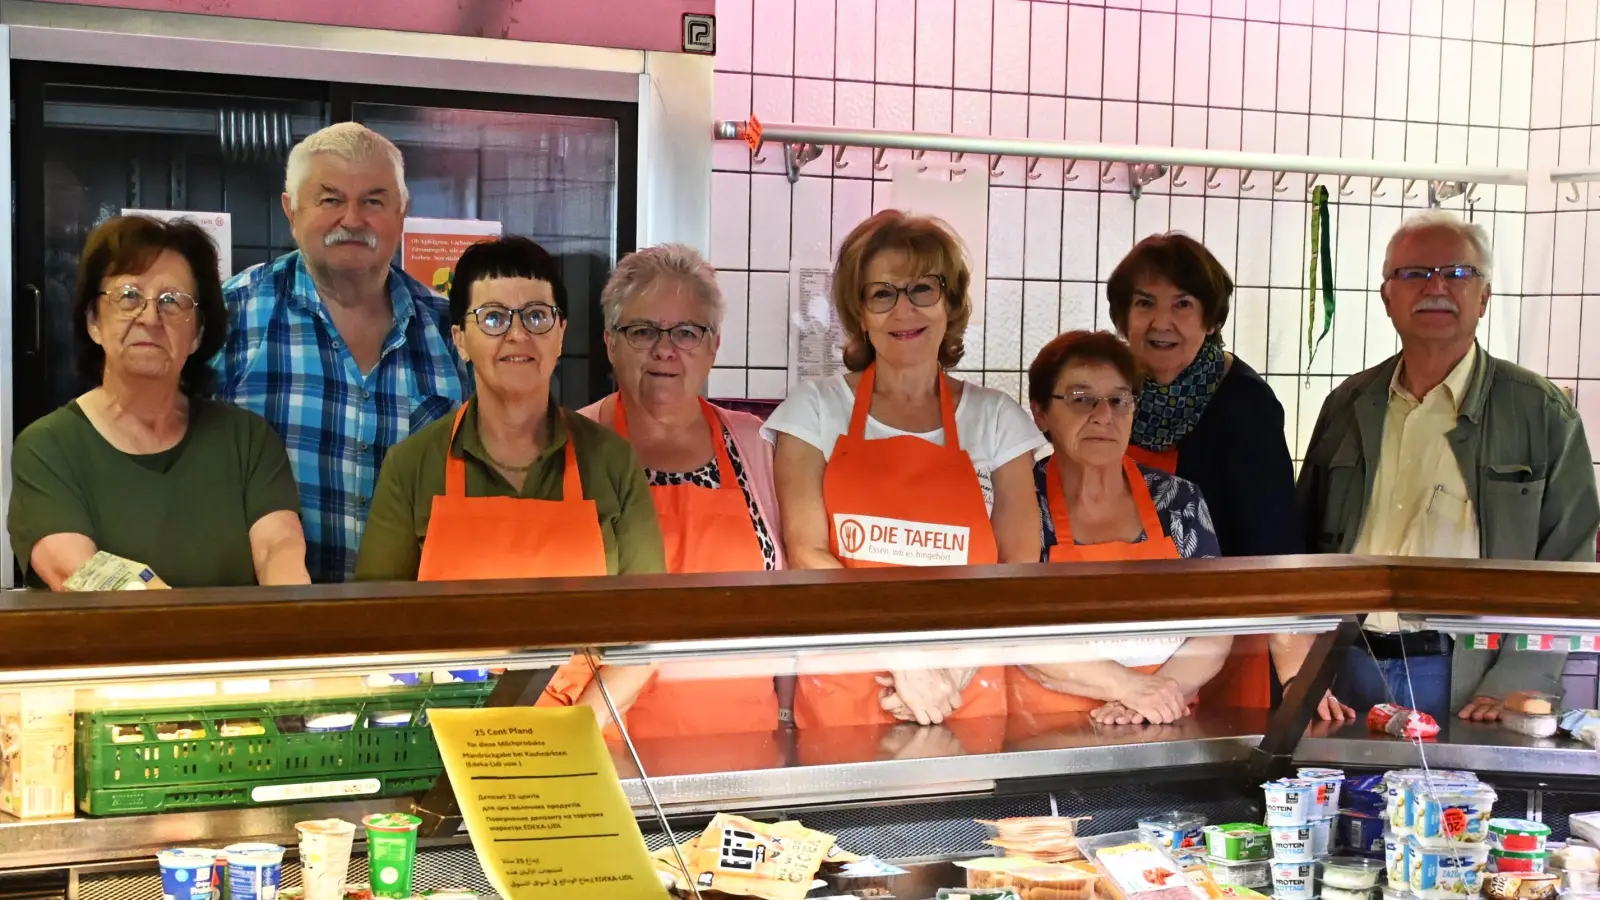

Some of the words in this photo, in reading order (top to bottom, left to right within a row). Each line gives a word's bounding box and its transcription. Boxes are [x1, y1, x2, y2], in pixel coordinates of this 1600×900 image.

[870, 524, 898, 544] DIE
[904, 528, 965, 552] TAFELN
[892, 549, 904, 557] wo
[915, 548, 952, 562] hingehört
[487, 728, 508, 736] Cent
[508, 727, 534, 735] Pfand
